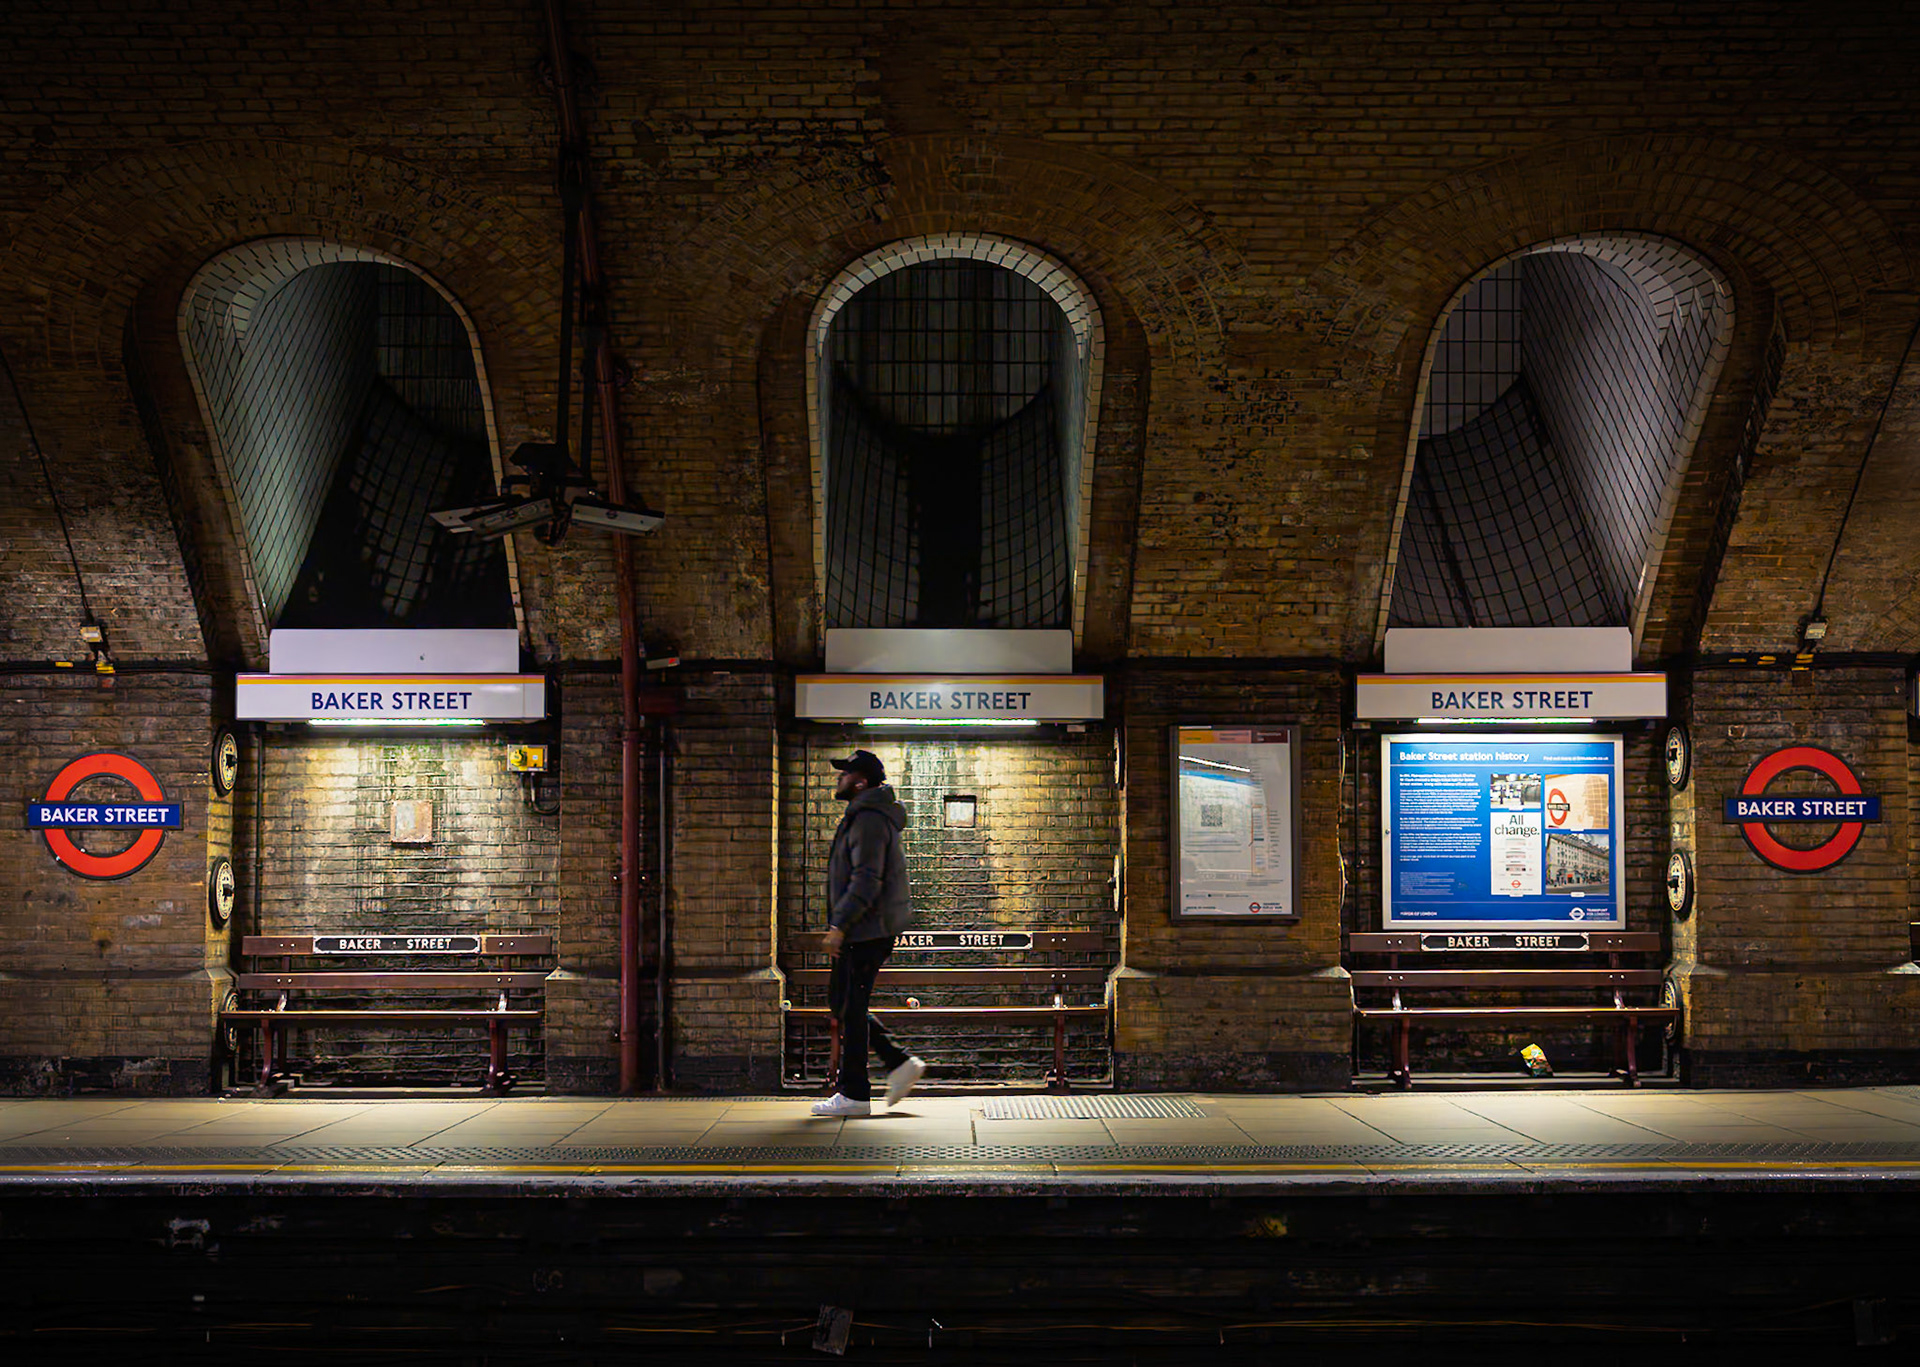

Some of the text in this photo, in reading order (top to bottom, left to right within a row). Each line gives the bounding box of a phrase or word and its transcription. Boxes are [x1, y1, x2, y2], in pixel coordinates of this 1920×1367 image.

[311, 692, 473, 710] BAKER STREET
[870, 692, 1031, 710] BAKER STREET
[1431, 691, 1594, 709] BAKER STREET
[1399, 752, 1530, 763] Baker Street station history
[40, 807, 169, 823] BAKER STREET
[1737, 801, 1867, 816] BAKER STREET
[1509, 814, 1524, 825] All
[1494, 824, 1540, 838] change.
[339, 938, 452, 949] BAKER STREET
[959, 935, 1004, 946] STREET
[1447, 936, 1561, 947] BAKER STREET
